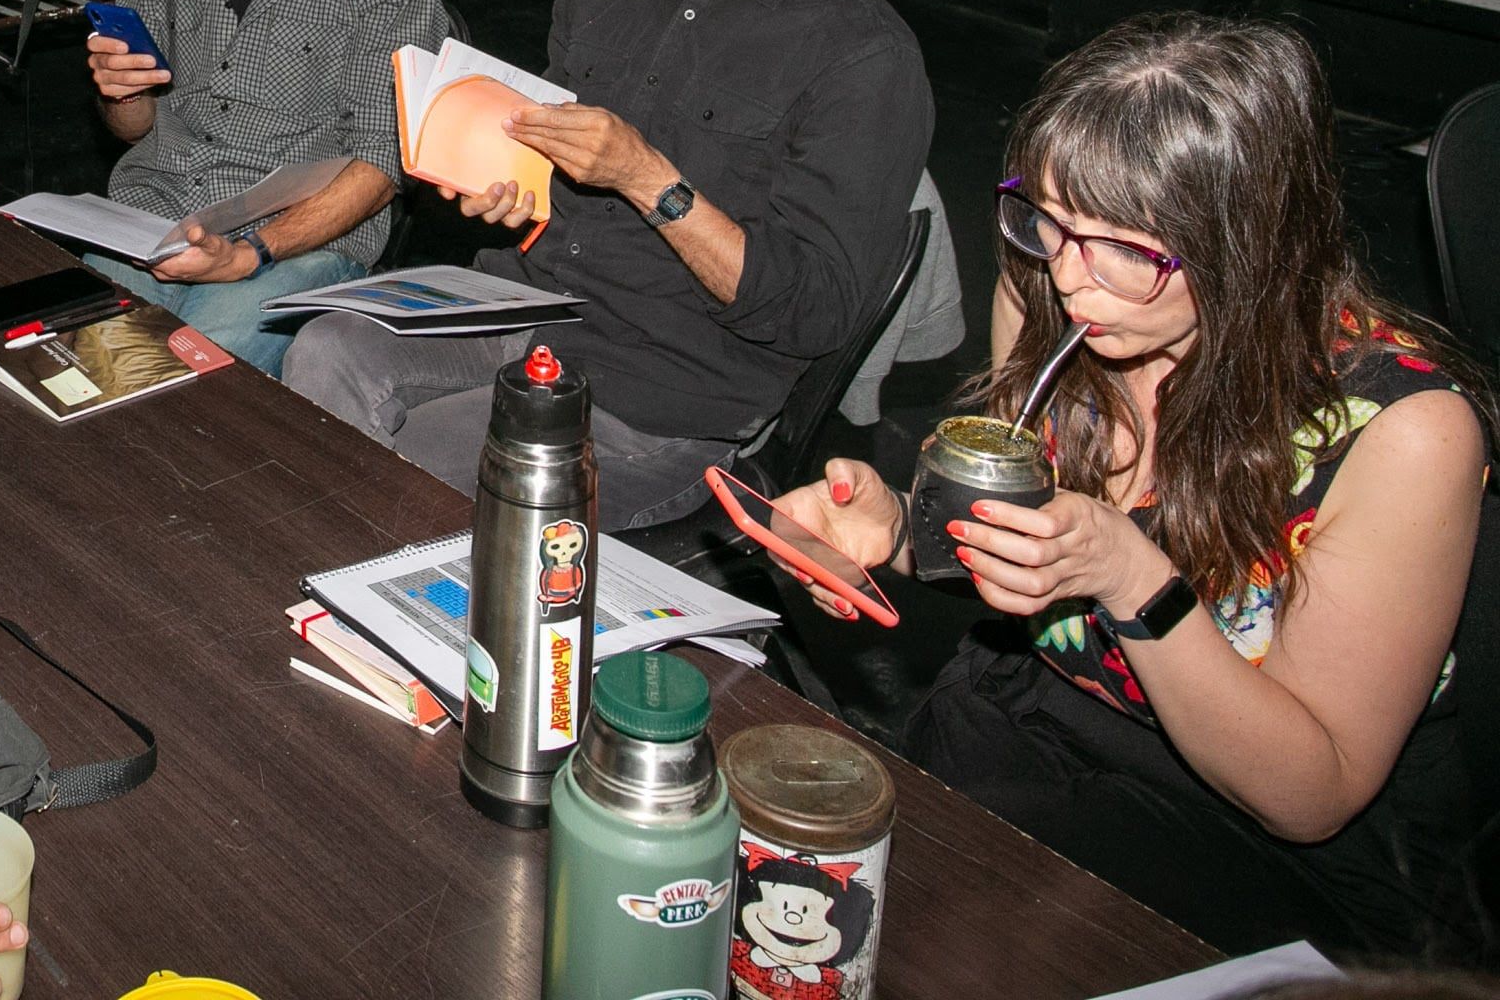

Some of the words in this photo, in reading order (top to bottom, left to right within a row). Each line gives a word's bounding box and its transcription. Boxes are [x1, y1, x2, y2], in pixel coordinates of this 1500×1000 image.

[551, 638, 571, 660] 4B
[661, 882, 708, 905] CENTRAL
[666, 904, 704, 922] PERK
